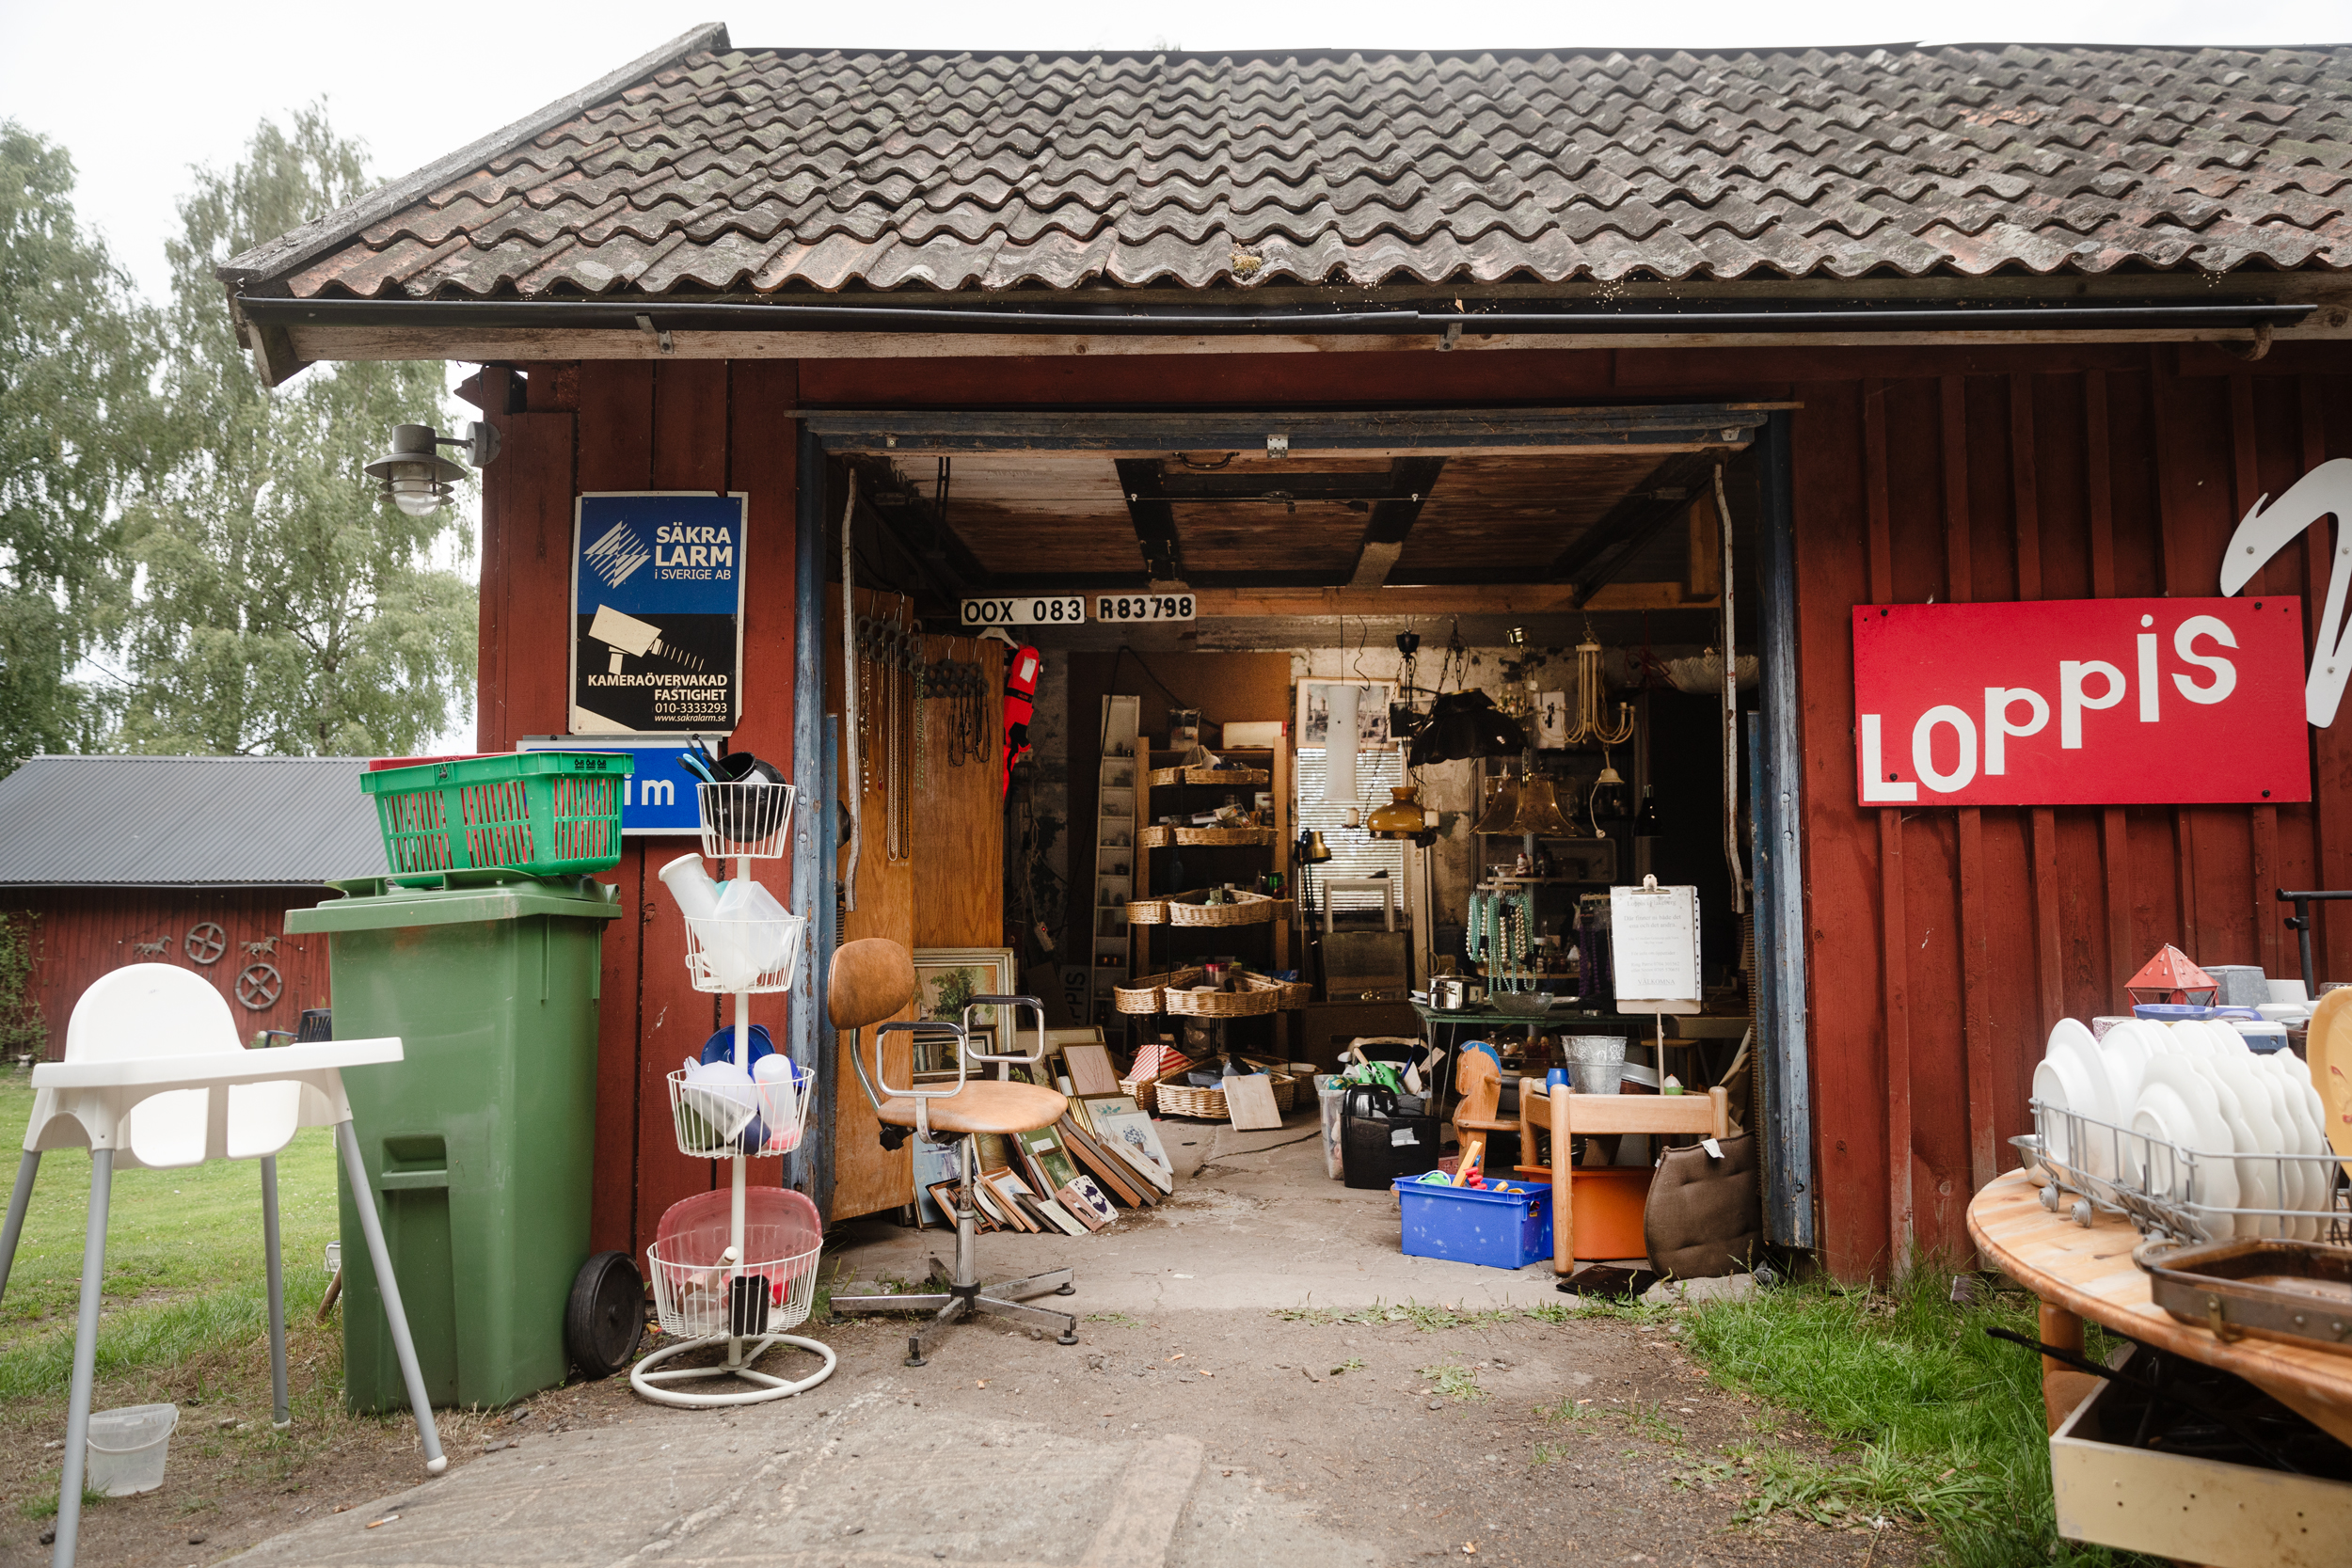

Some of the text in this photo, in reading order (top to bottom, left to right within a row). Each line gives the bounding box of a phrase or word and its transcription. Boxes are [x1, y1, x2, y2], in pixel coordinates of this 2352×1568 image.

[656, 521, 732, 545] SÄKRA
[655, 545, 733, 567] LARM
[654, 568, 732, 580] i SVERIGE AB
[964, 599, 1081, 623] OOX 083
[587, 672, 728, 687] KAMERAÖVERVAKAD
[654, 689, 727, 701] FASTIGHET
[655, 702, 728, 714] 010-3333293
[654, 714, 727, 722] www.sakralarm.se
